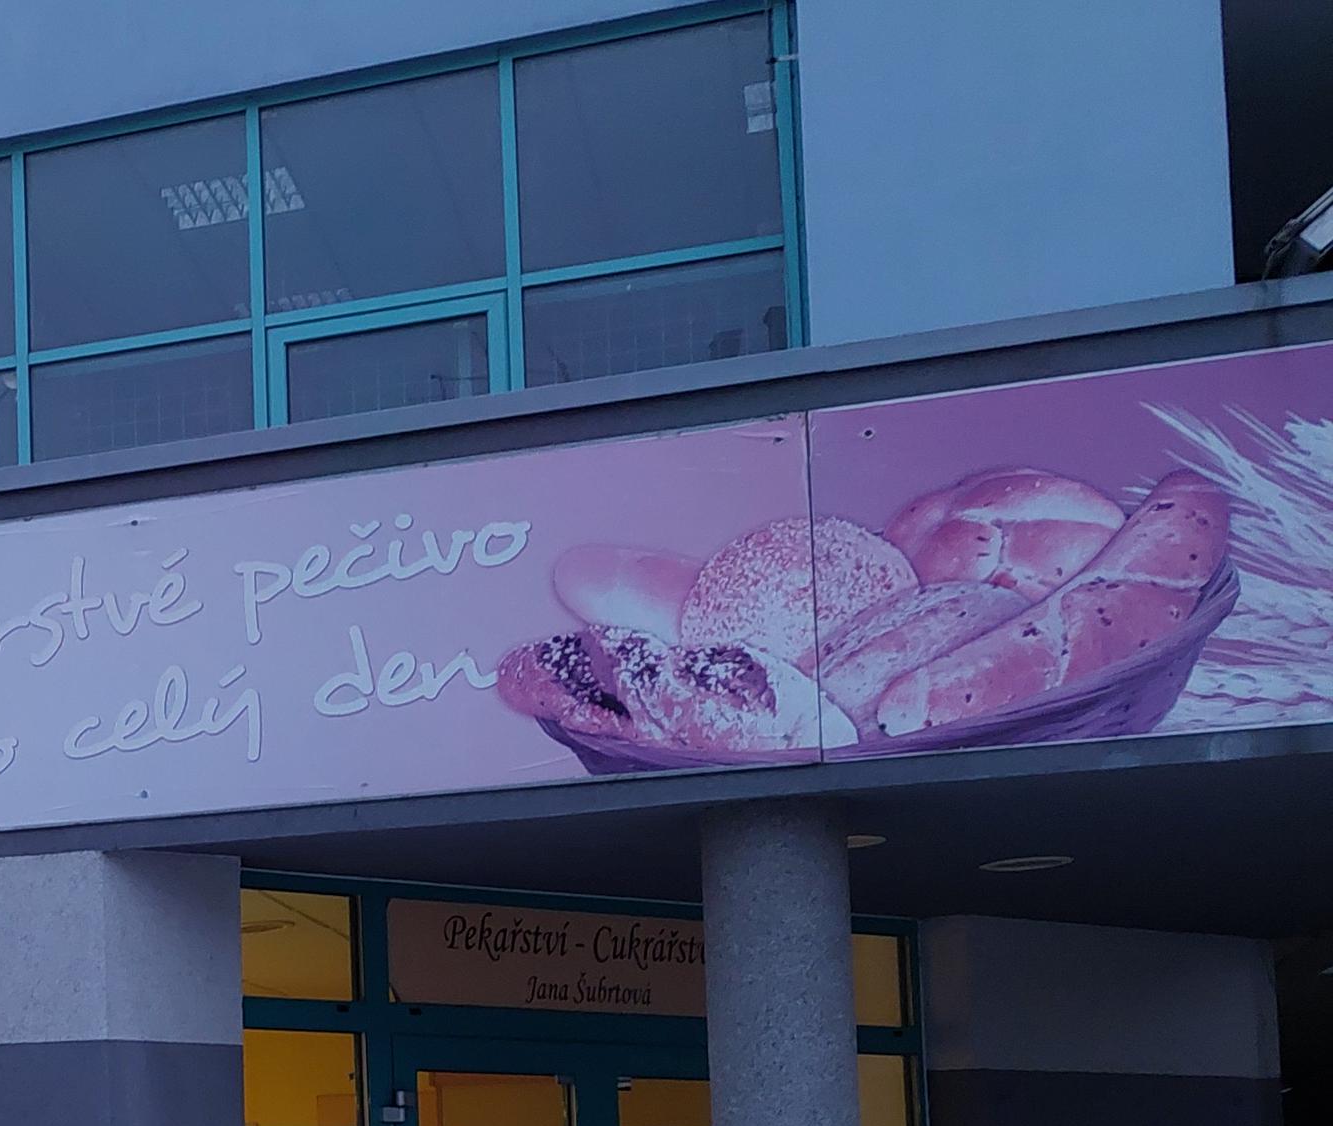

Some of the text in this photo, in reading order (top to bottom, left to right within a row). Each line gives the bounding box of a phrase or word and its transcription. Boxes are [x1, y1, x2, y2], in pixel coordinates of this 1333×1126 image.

[234, 514, 532, 645] pečivo
[63, 665, 262, 764] celý
[313, 625, 495, 718] den
[444, 912, 570, 962] Pekařství
[525, 972, 652, 1007] Jana Šubrtová
